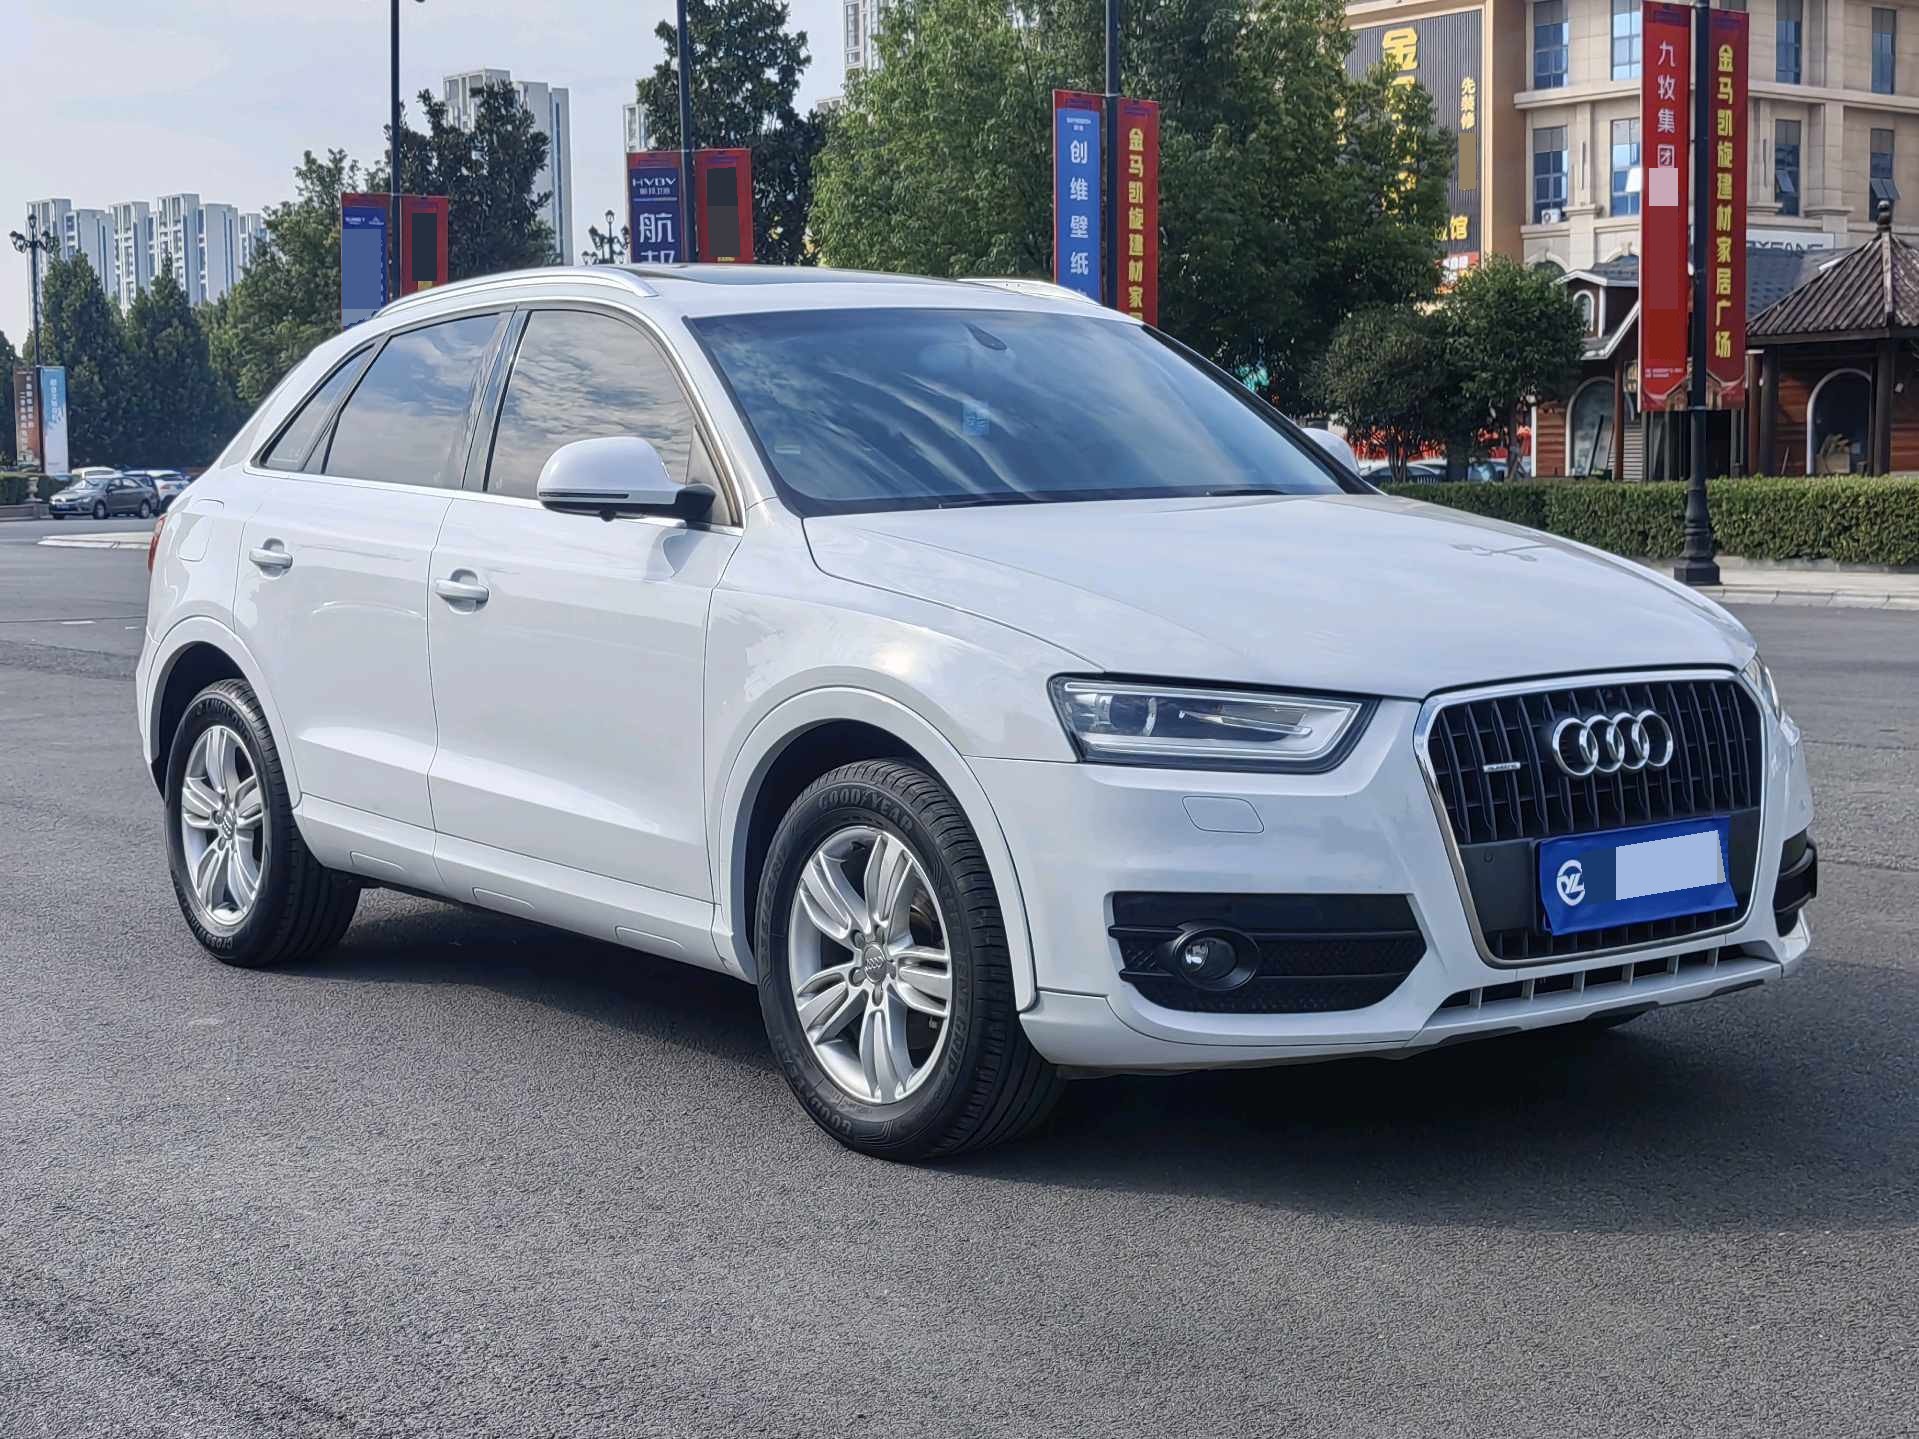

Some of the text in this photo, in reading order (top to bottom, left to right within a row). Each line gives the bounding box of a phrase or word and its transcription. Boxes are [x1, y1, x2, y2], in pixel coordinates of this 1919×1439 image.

[1656, 40, 1676, 168] 九牧集团
[1070, 140, 1088, 297] 创维壁纸
[1715, 44, 1733, 358] 金马凯旋建材家居广场
[818, 788, 912, 833] GOODYEAR
